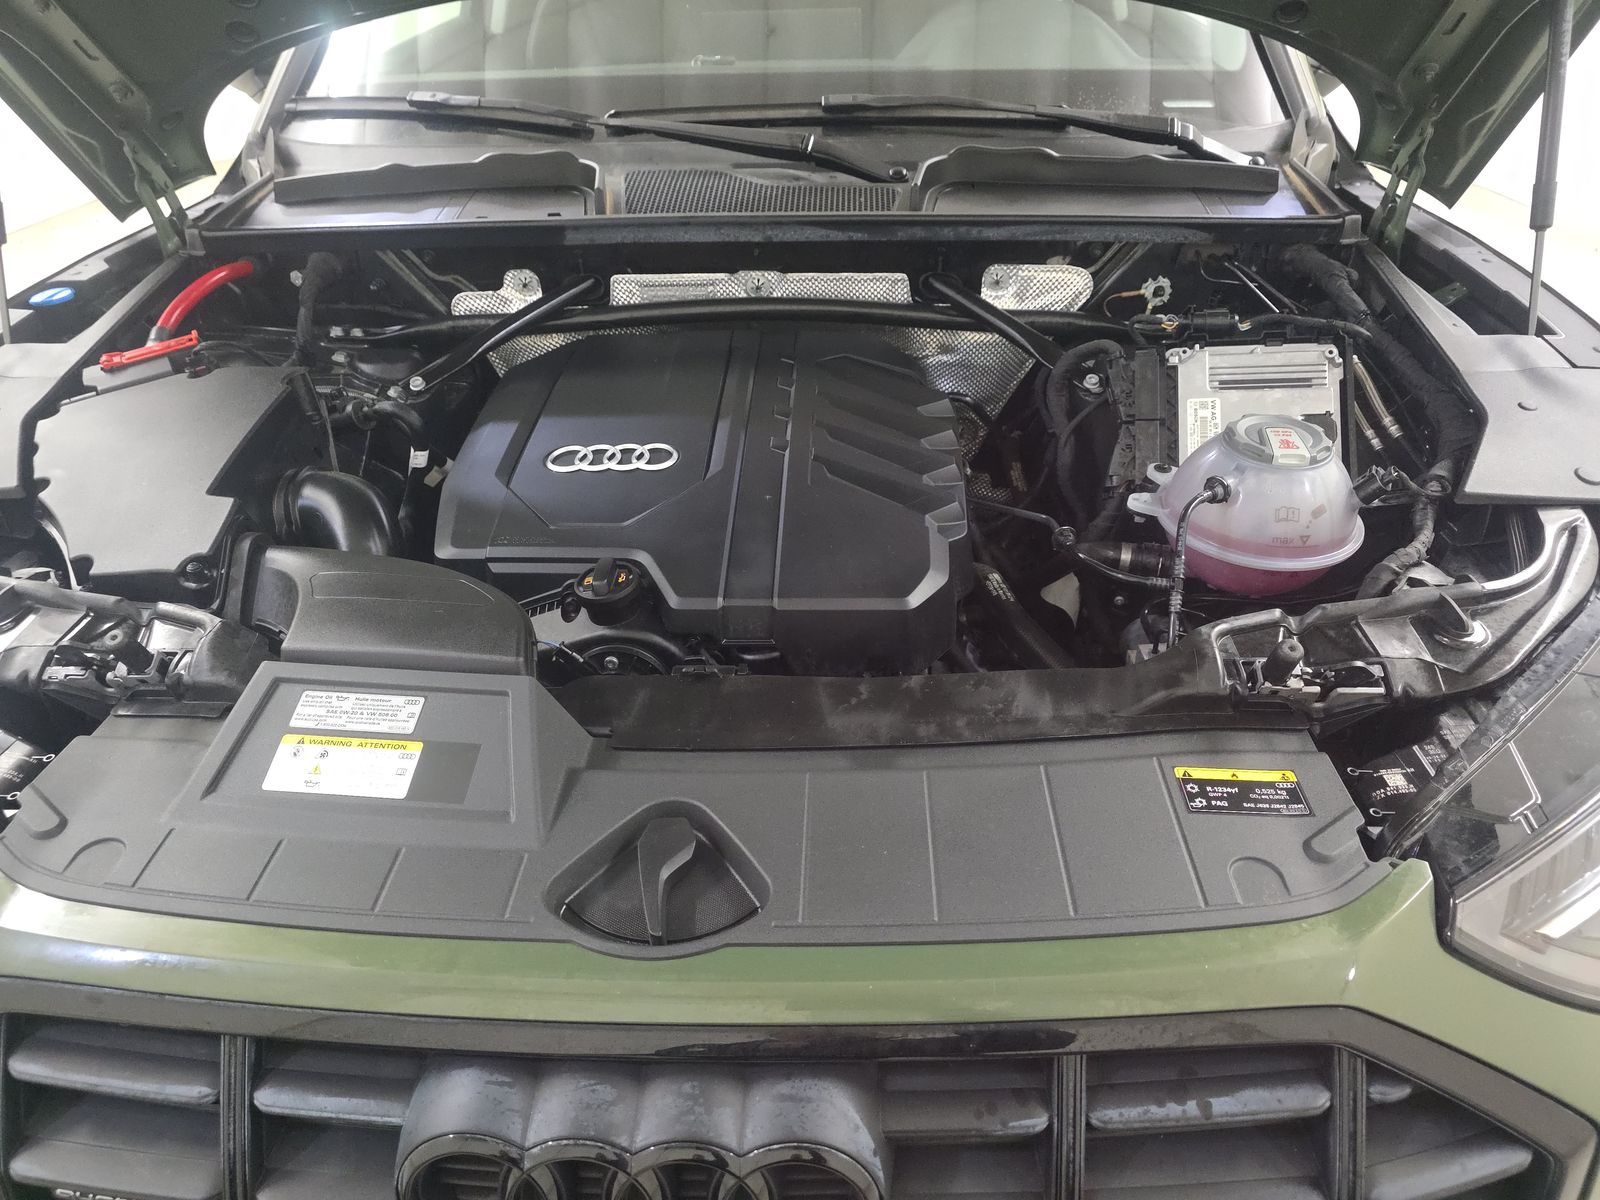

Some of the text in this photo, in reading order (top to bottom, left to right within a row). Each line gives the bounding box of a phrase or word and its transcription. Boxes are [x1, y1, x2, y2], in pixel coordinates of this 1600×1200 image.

[1272, 537, 1296, 545] max
[309, 739, 408, 750] WARNING ATTENTION
